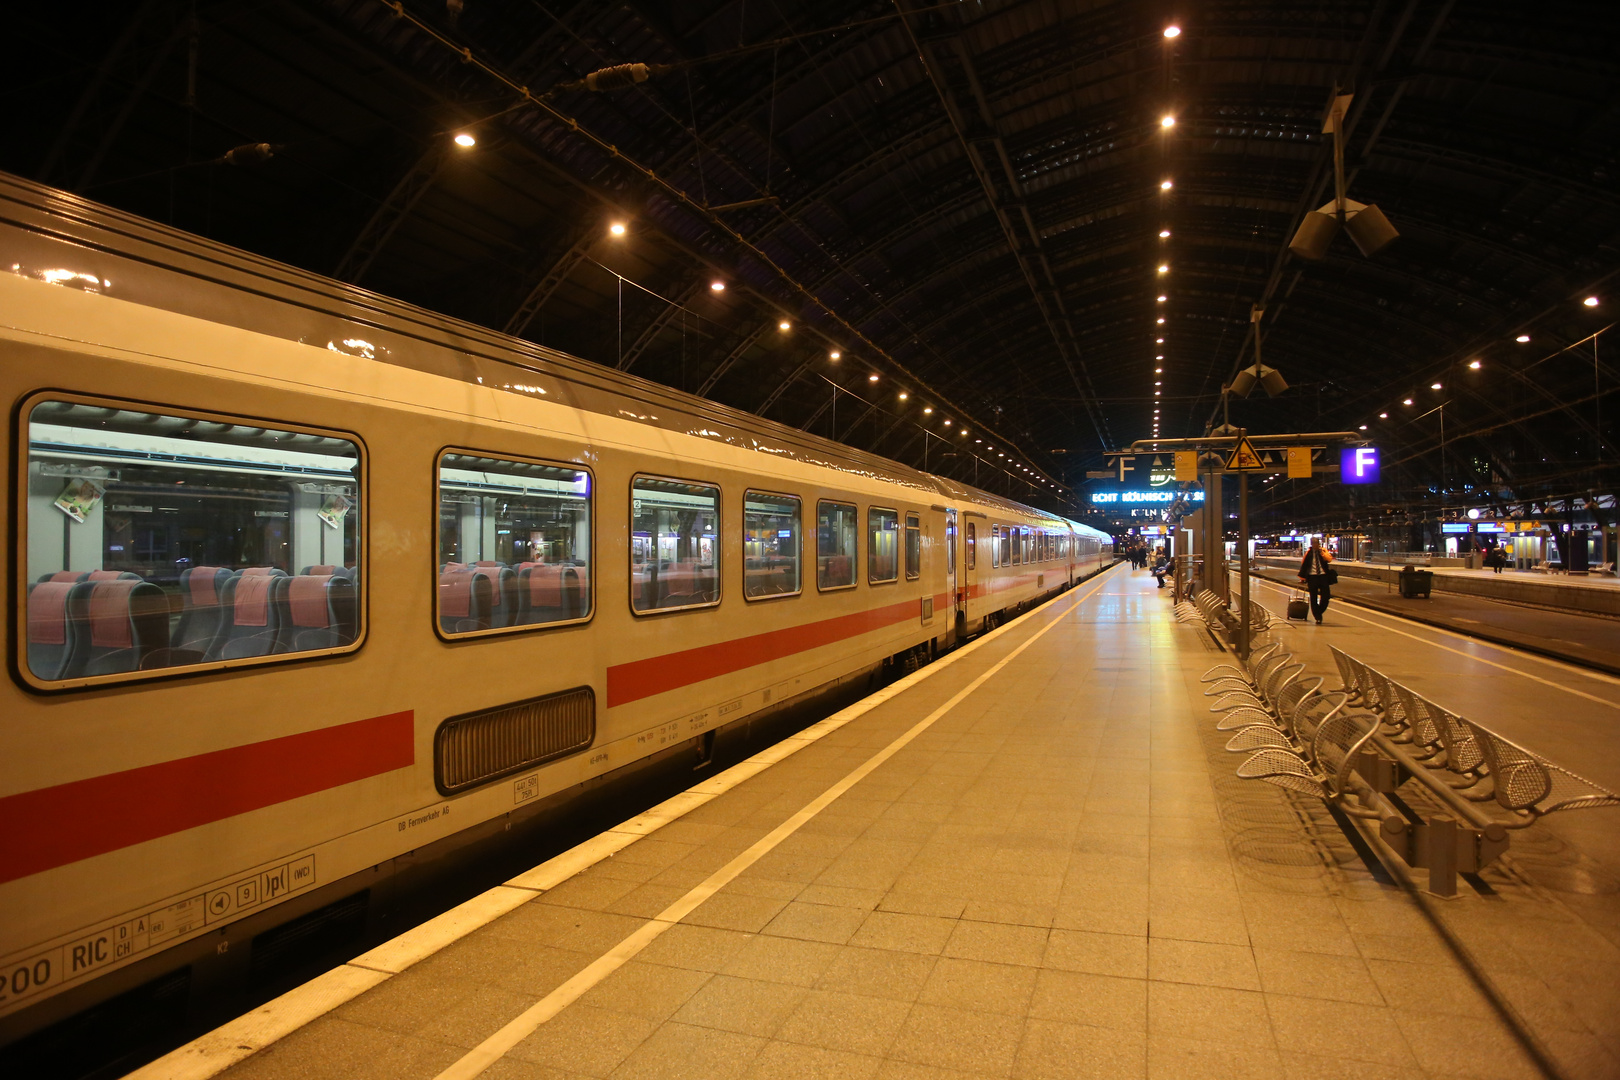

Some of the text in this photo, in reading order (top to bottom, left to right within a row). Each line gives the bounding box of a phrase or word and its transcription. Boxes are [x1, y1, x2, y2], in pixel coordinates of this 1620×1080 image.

[1120, 456, 1135, 482] F
[1356, 448, 1375, 477] F
[1092, 493, 1118, 502] ECHT
[1122, 491, 1173, 502] KÖLNISCH
[398, 805, 450, 832] DB Fernverkehr AG
[243, 888, 250, 899] 9
[294, 866, 310, 881] (WC)
[120, 920, 145, 939] D A
[72, 936, 108, 973] RIC
[117, 941, 130, 957] CH
[217, 941, 229, 955] K2
